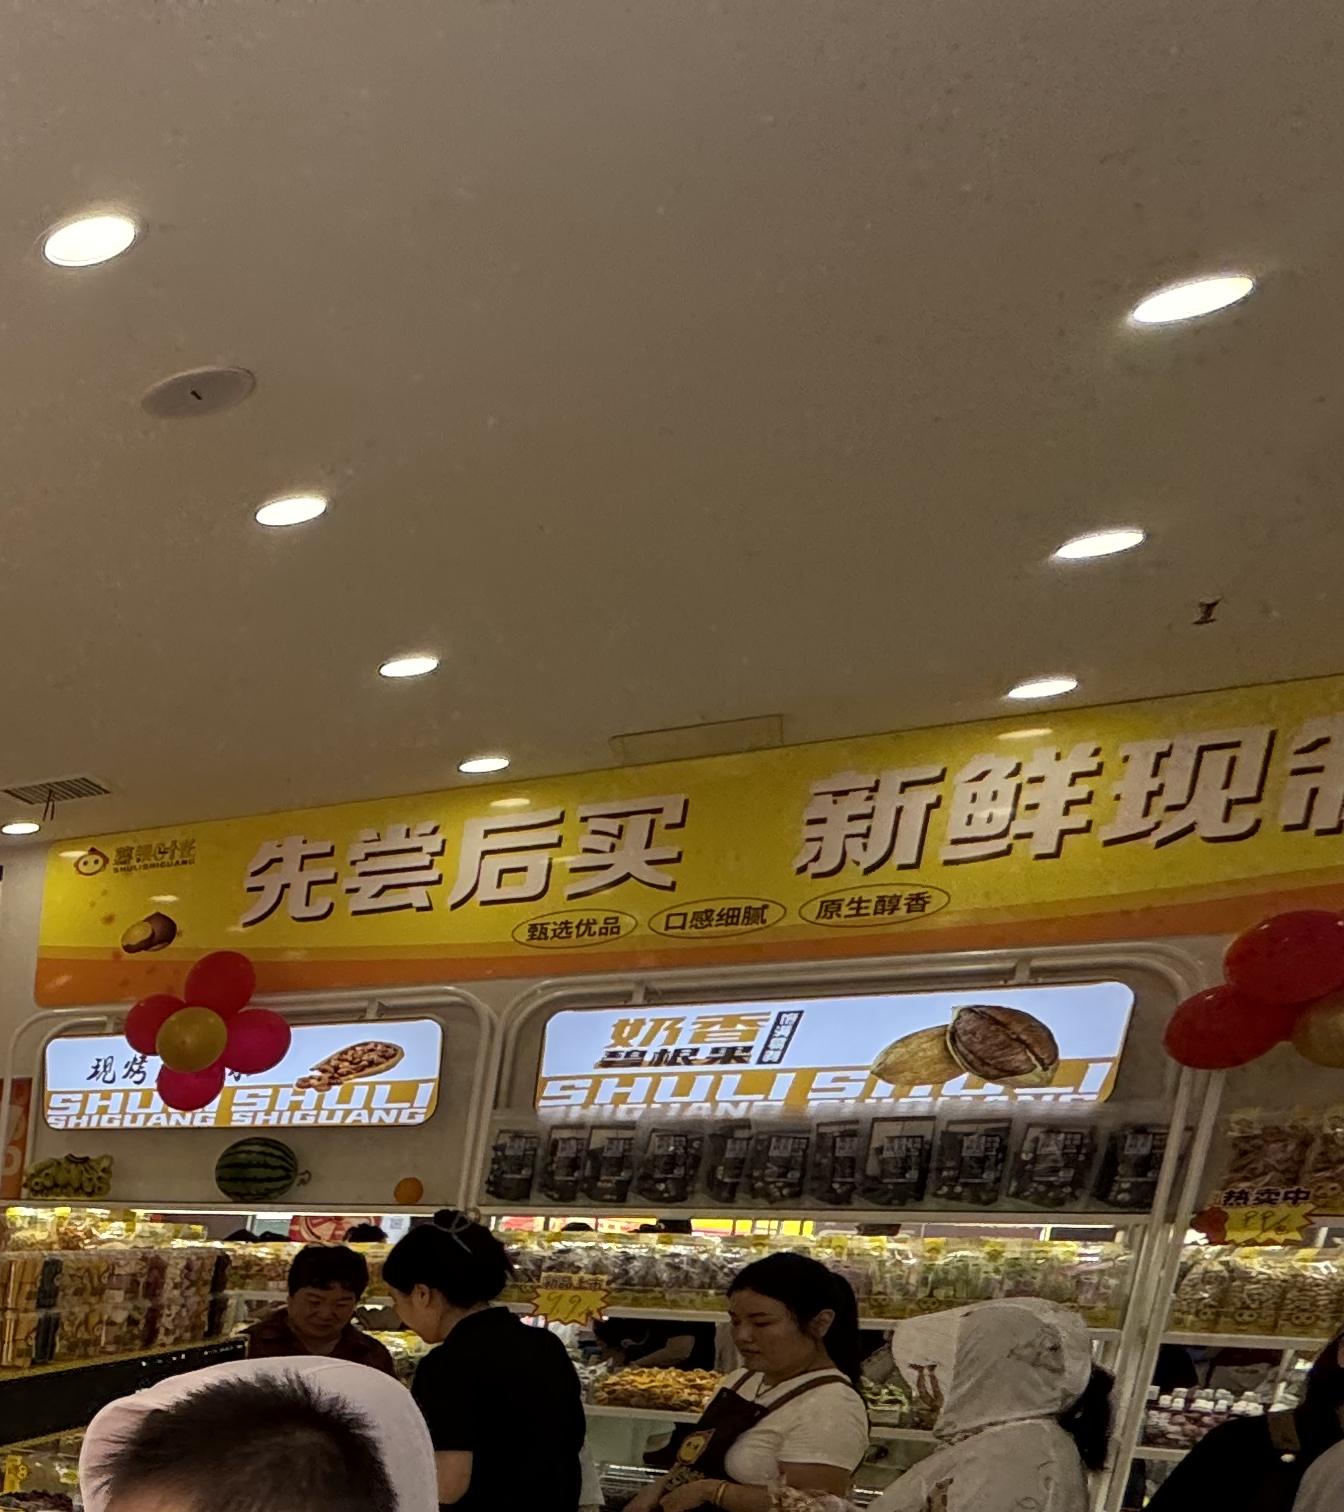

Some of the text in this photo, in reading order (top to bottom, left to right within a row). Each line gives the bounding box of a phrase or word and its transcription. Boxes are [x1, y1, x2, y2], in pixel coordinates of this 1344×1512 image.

[241, 794, 689, 928] 先尝后买
[525, 891, 931, 942] 甄选优品 口感细腻 原生醇香
[604, 1011, 771, 1048] 奶香
[230, 1082, 435, 1112] SHULI
[539, 1072, 796, 1107] SHULI
[47, 1107, 427, 1128] SHIGUANG SHIGUANG
[1223, 1188, 1310, 1206] 热卖中
